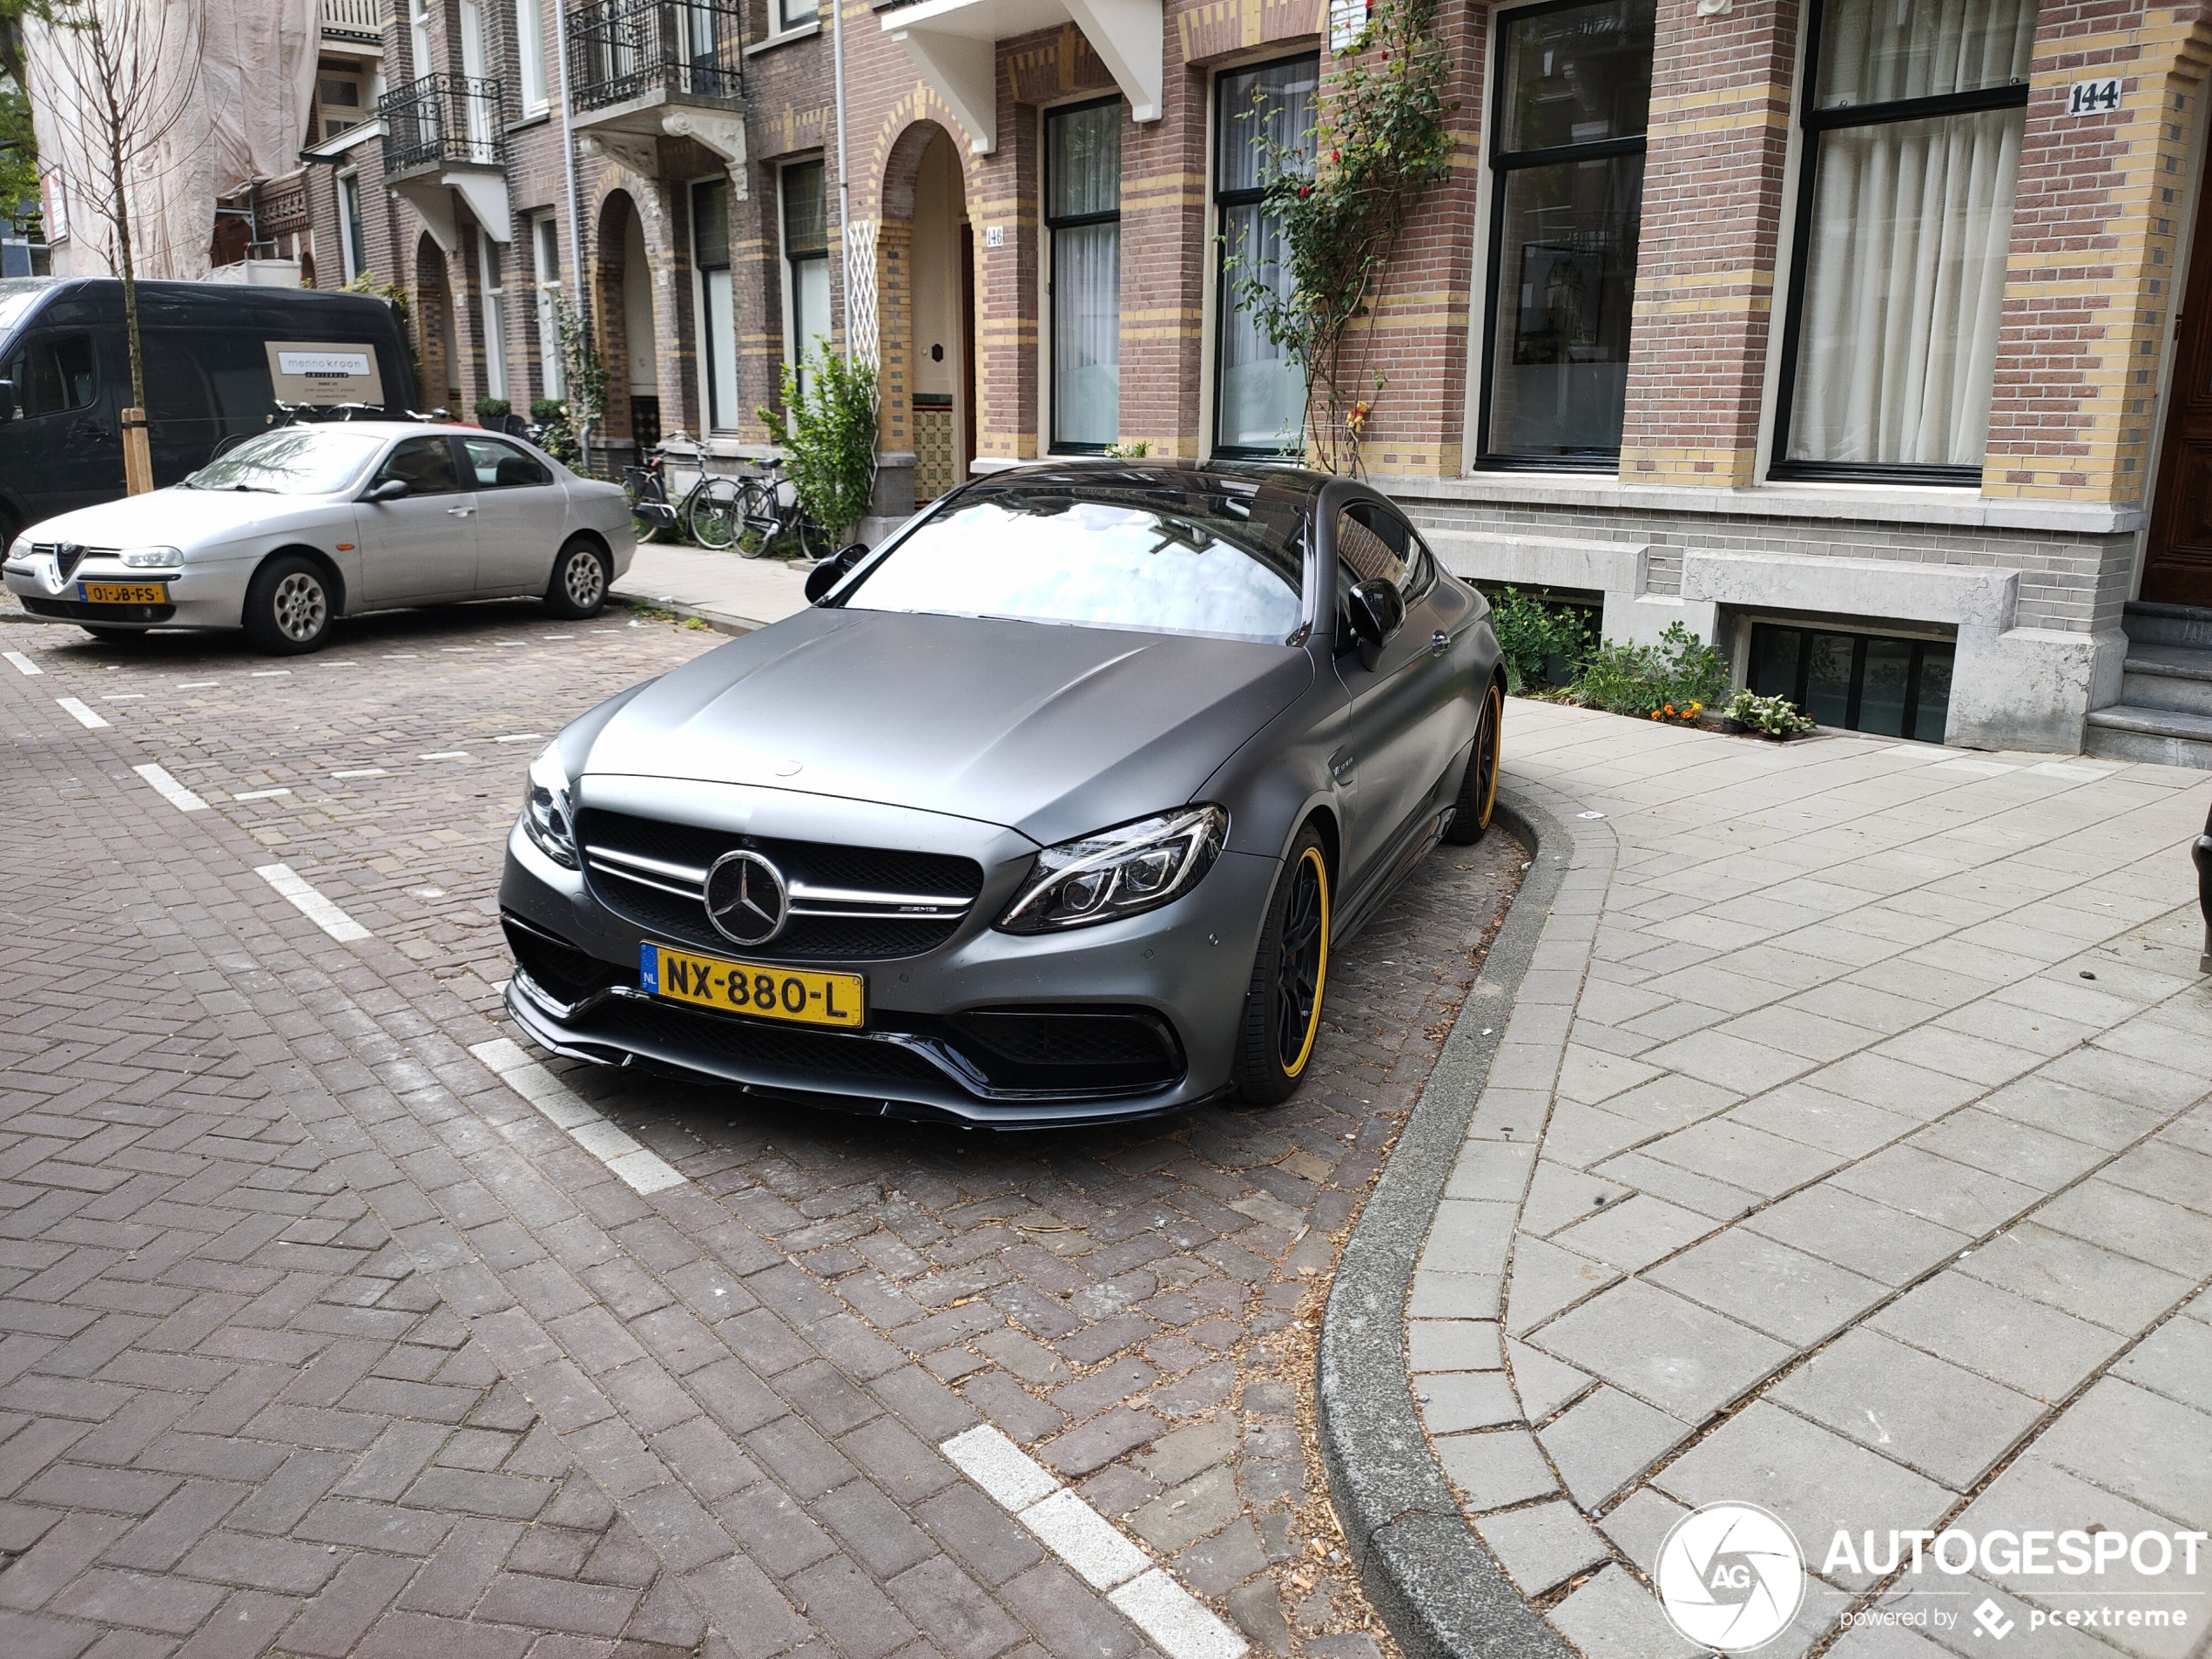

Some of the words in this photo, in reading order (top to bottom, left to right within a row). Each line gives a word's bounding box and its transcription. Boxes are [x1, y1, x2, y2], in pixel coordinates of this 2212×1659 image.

[2071, 80, 2119, 113] 144
[988, 228, 1002, 245] 146
[93, 587, 155, 601] 01-JB-FS
[644, 971, 657, 985] NL
[667, 956, 847, 1018] NX-880-L
